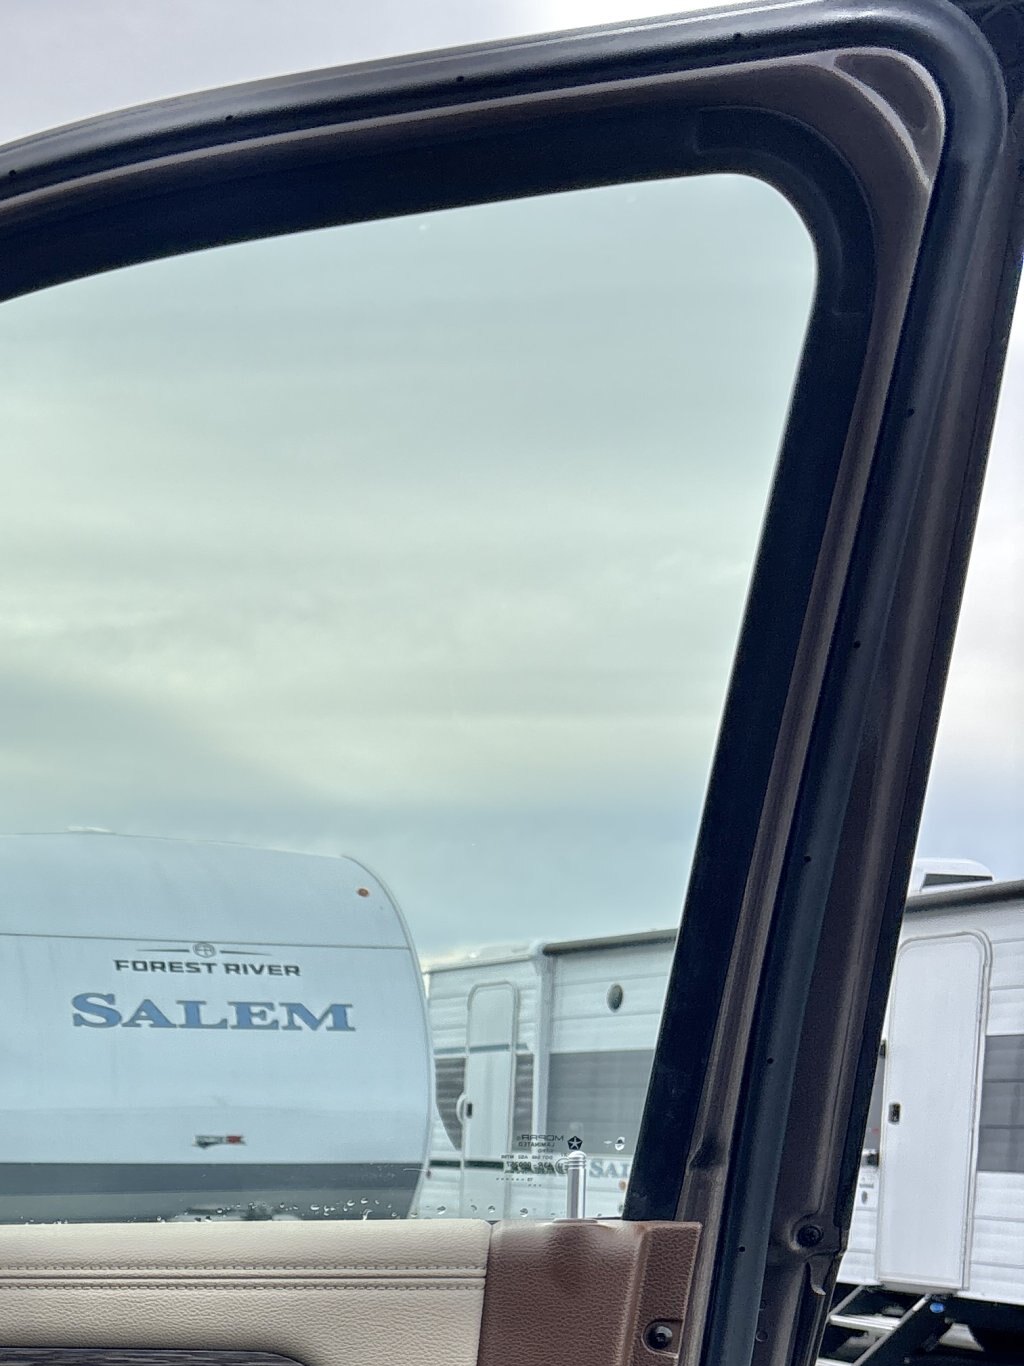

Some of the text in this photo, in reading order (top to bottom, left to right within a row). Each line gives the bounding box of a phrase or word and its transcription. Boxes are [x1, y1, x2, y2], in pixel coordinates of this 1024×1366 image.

[113, 958, 302, 977] FOREST RIVER
[71, 991, 357, 1032] SALEM
